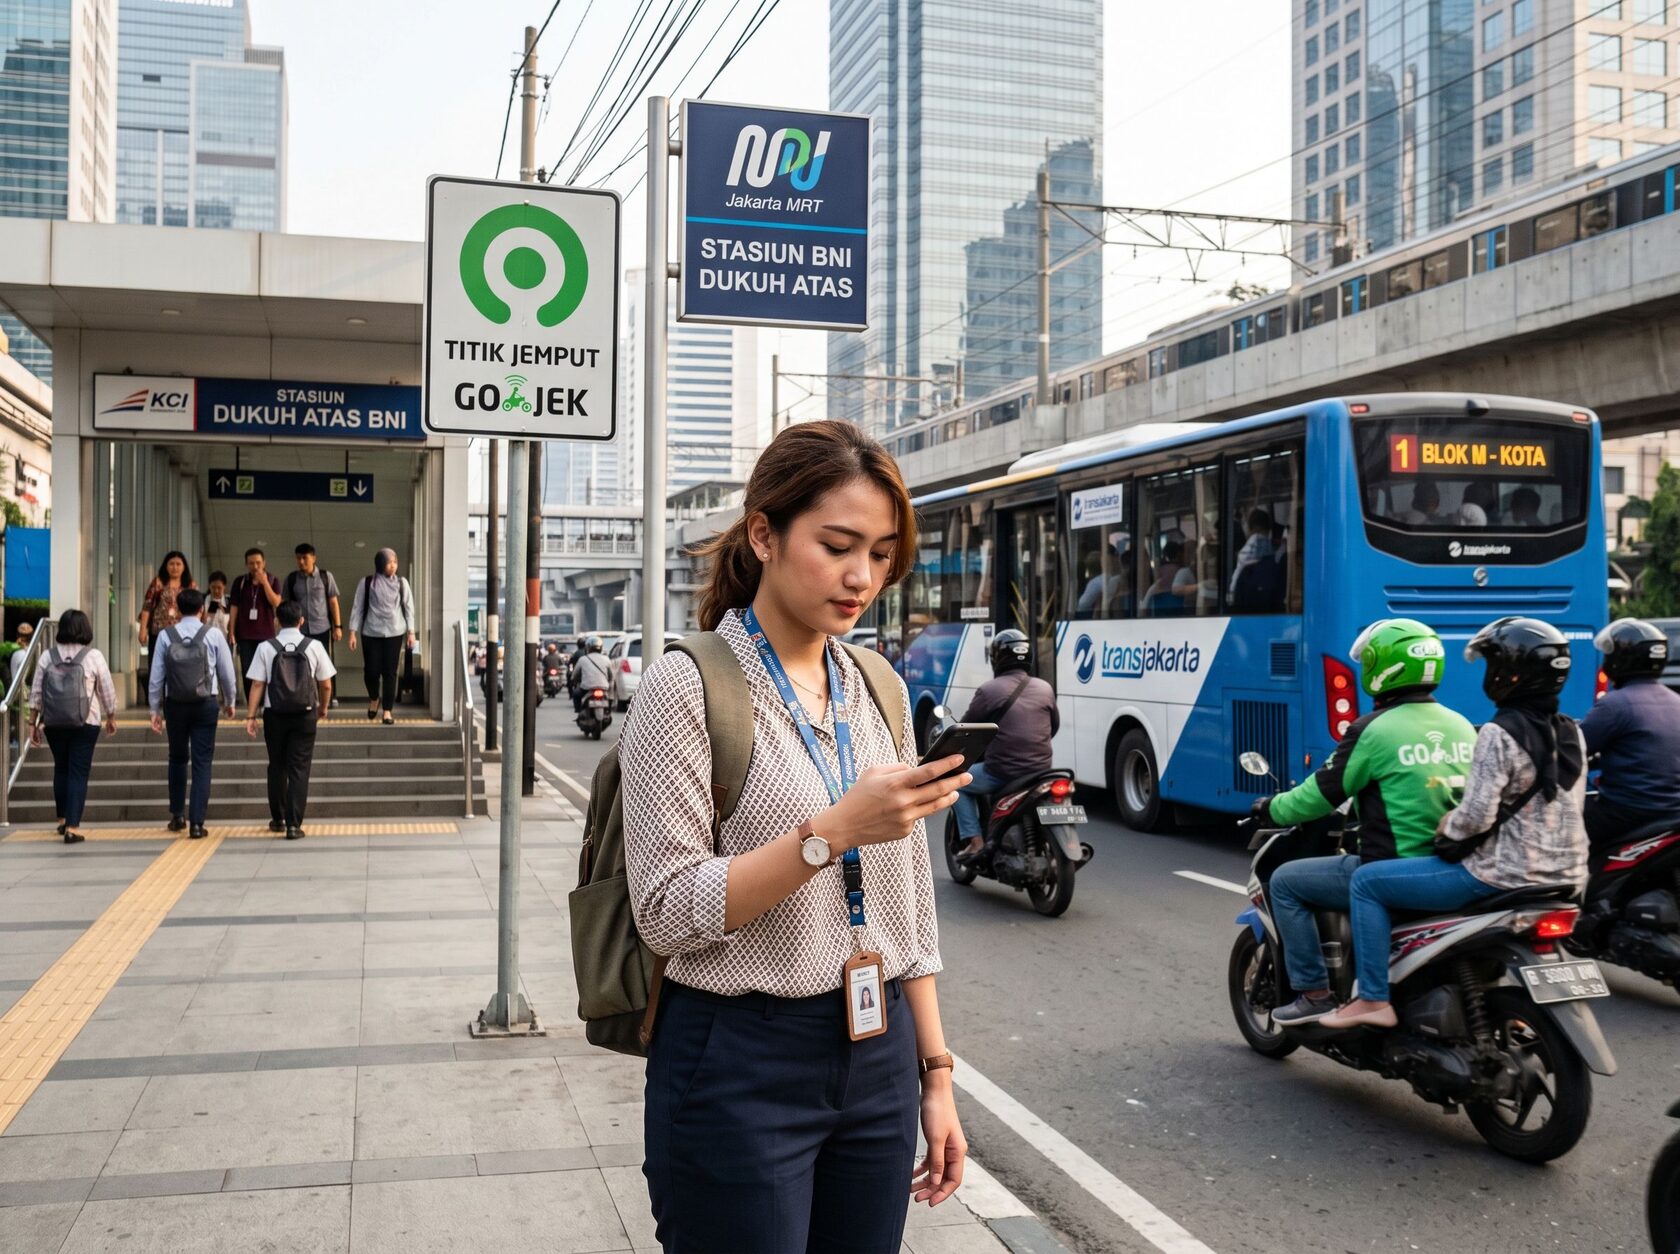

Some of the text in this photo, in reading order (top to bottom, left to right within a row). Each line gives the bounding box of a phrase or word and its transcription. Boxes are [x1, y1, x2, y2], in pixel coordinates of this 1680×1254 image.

[725, 193, 824, 213] Jakarta MRT
[700, 238, 852, 268] STASIUN BNI
[699, 268, 853, 298] DUKUH ATAS
[444, 339, 600, 368] TITIK JEMPUT
[150, 392, 189, 408] KCI
[276, 388, 345, 405] STASIUN
[213, 405, 407, 429] DUKUH ATAS BNI
[1395, 438, 1409, 469] 1
[1421, 441, 1468, 466] BLOK
[1471, 443, 1487, 466] M
[1500, 444, 1547, 467] KOTA
[1101, 640, 1200, 679] transjakarta
